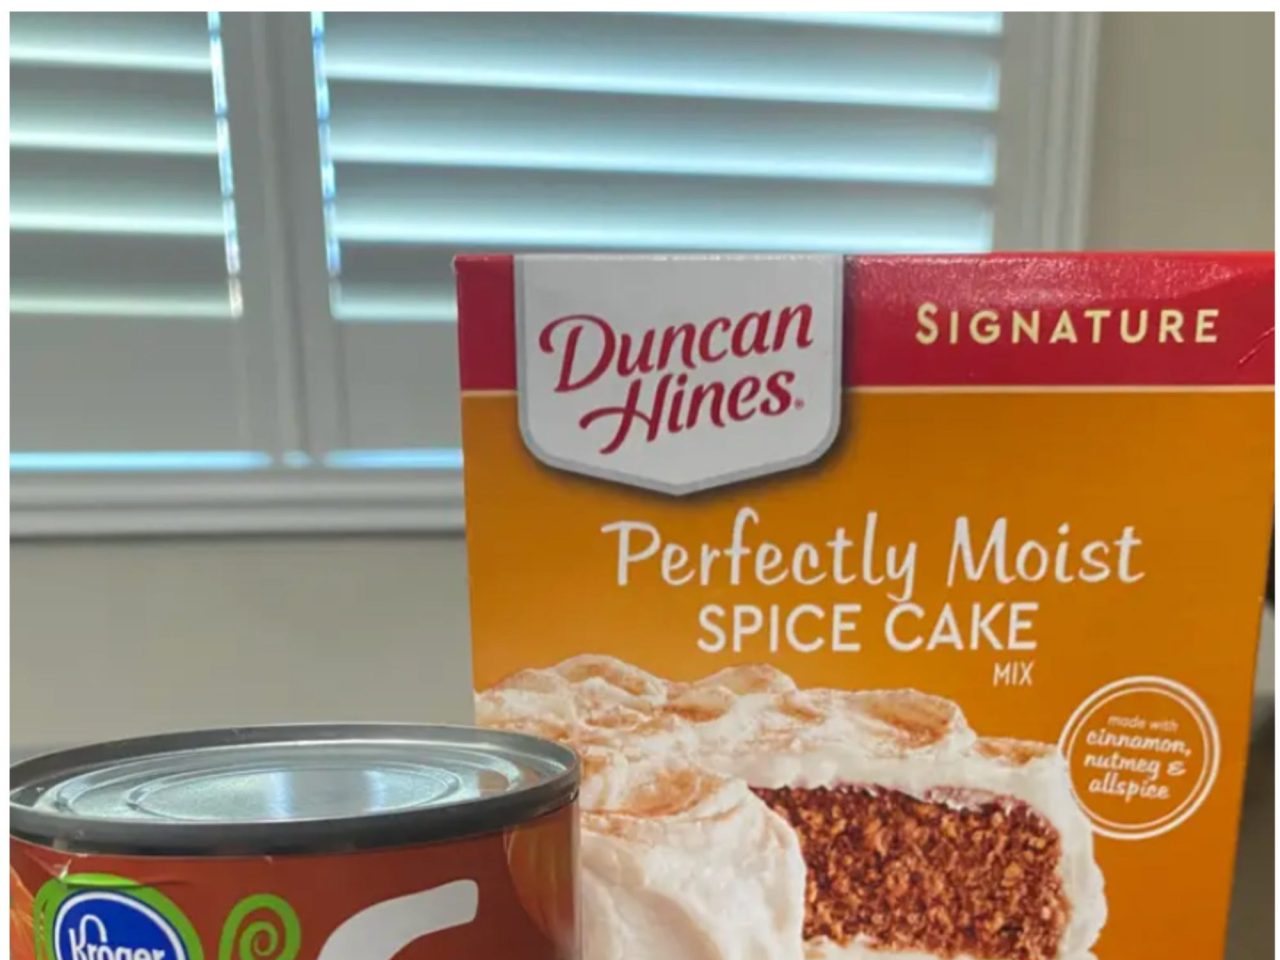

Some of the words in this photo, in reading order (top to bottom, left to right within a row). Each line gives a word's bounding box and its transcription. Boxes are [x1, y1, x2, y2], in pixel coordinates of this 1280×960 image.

[915, 303, 1219, 346] SIGNATURE
[538, 301, 814, 394] Duncan
[601, 507, 917, 603] Perfectly
[947, 515, 1145, 589] Moist
[696, 602, 861, 654] SPICE
[884, 601, 1039, 652] CAKE
[993, 661, 1034, 687] MIX
[1108, 714, 1146, 730] made
[1149, 718, 1179, 732] with
[1086, 728, 1192, 757] cinnamon,
[1084, 752, 1161, 781] nutmeg
[1166, 760, 1187, 777] &
[1088, 771, 1171, 803] allspice
